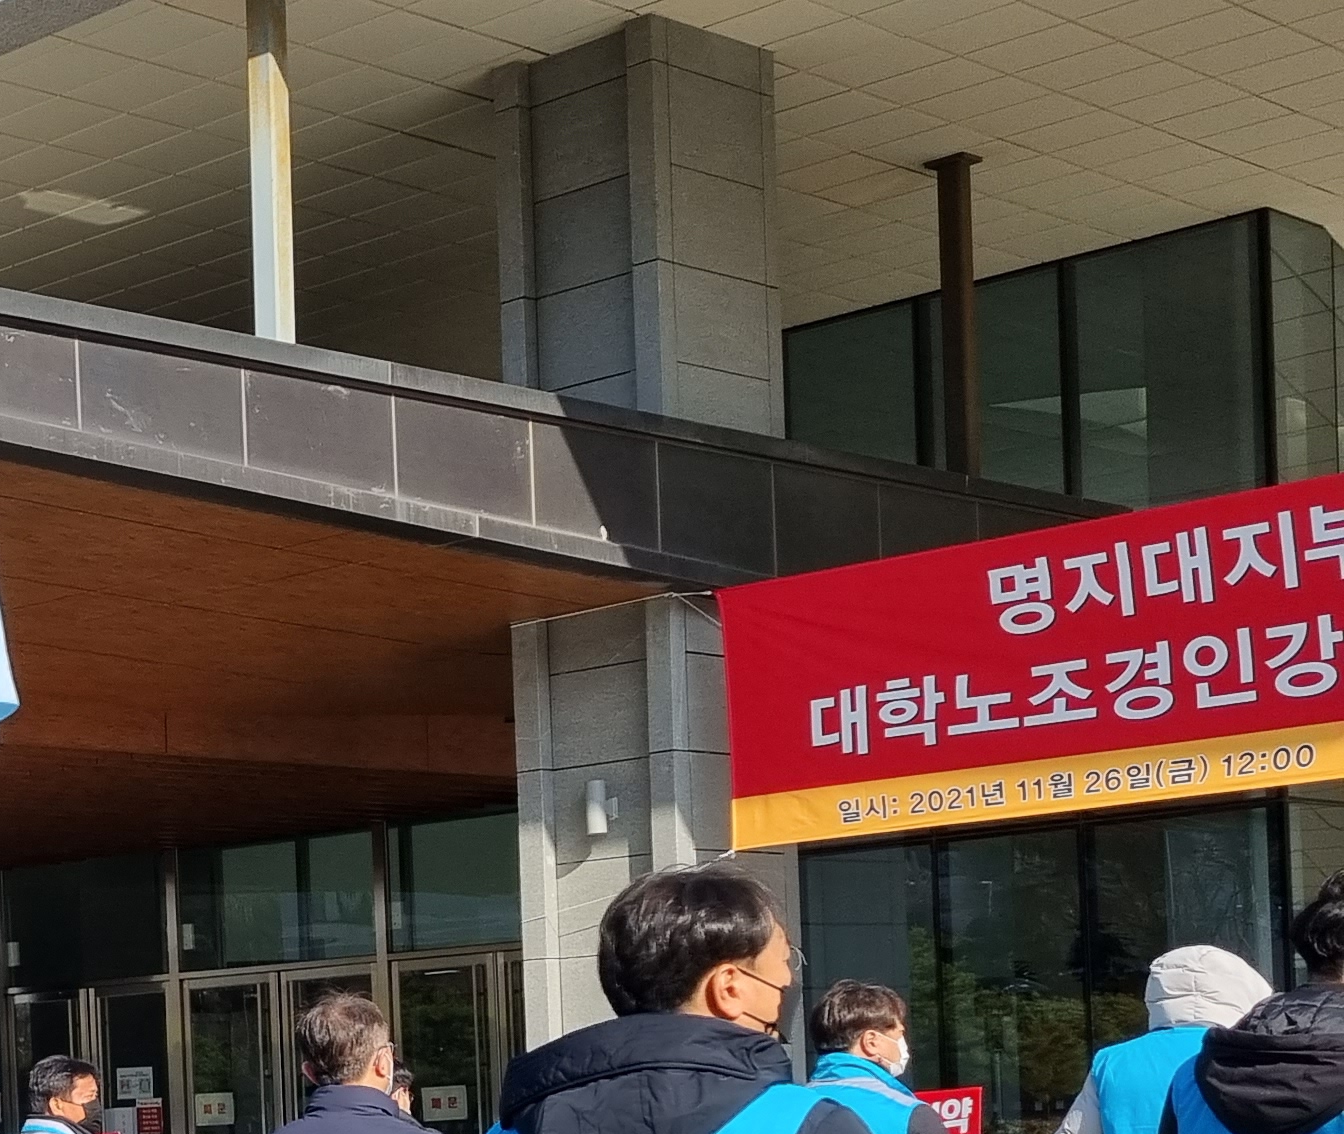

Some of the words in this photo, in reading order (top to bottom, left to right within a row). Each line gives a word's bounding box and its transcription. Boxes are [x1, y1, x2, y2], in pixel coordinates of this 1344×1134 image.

[837, 793, 899, 824] 일시:
[909, 780, 1006, 816] 2021년
[1016, 772, 1074, 802] 11월
[1084, 753, 1209, 795] 26일(금)
[1221, 743, 1317, 778] 12:00
